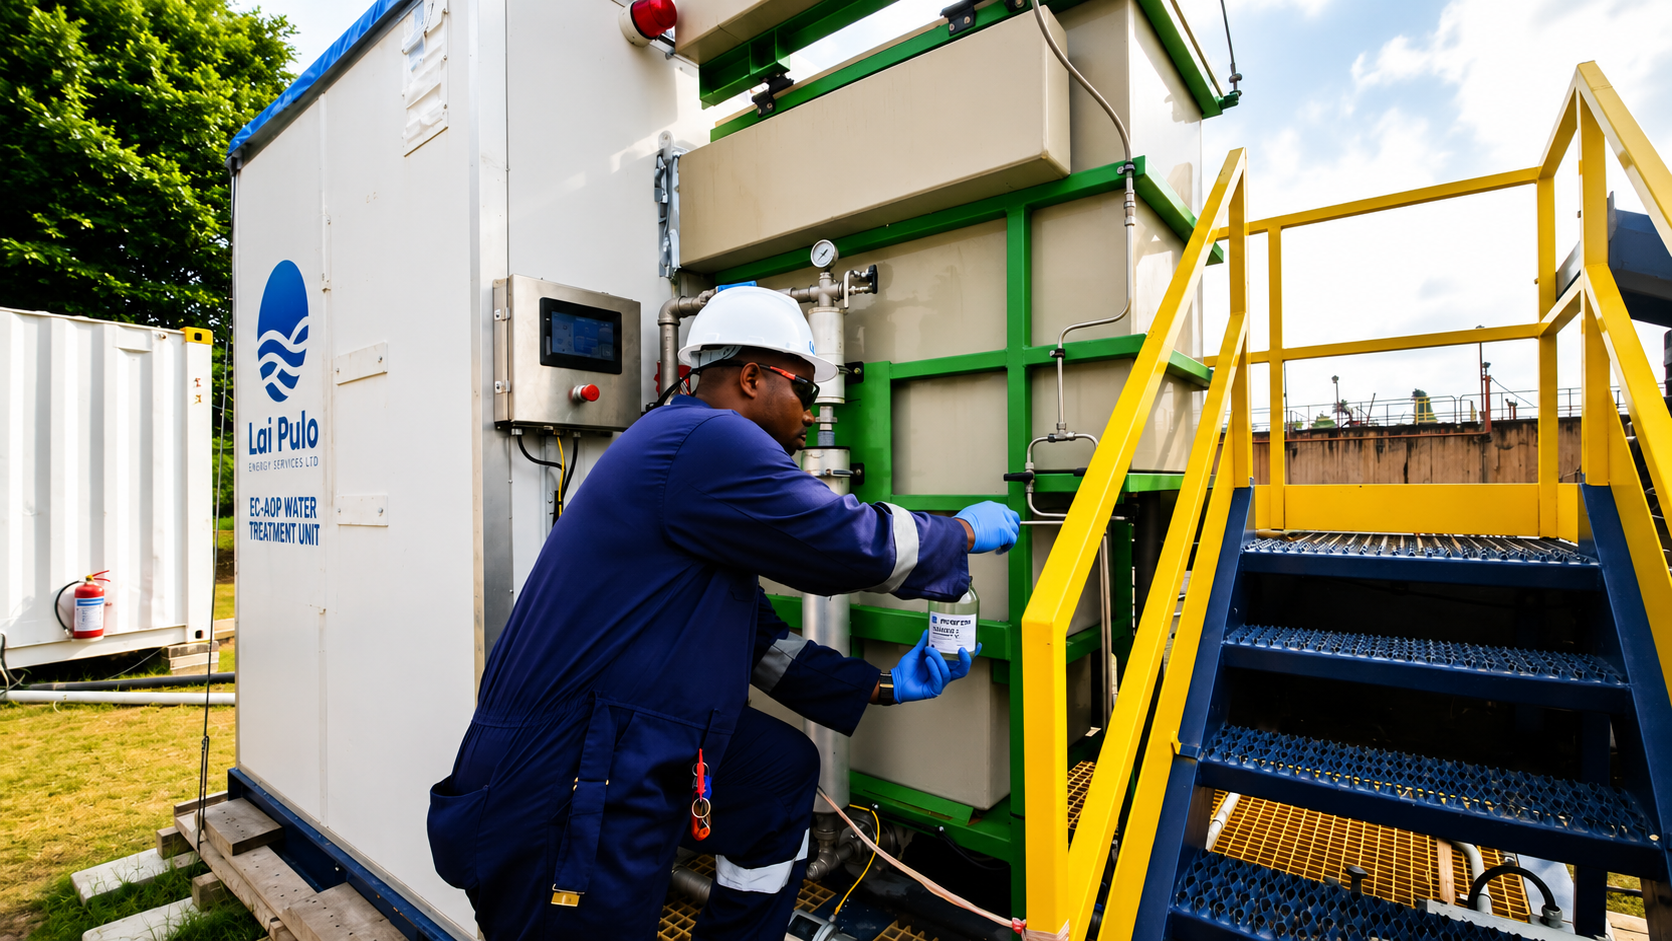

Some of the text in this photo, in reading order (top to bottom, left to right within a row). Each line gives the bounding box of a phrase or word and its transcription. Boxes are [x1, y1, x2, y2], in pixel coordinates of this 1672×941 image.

[249, 410, 319, 455] Lai Pulo
[248, 455, 319, 473] ENERGY SERVICES LTD
[249, 496, 317, 519] EC-AOP WATER
[249, 520, 320, 546] TREATMENT UNIT
